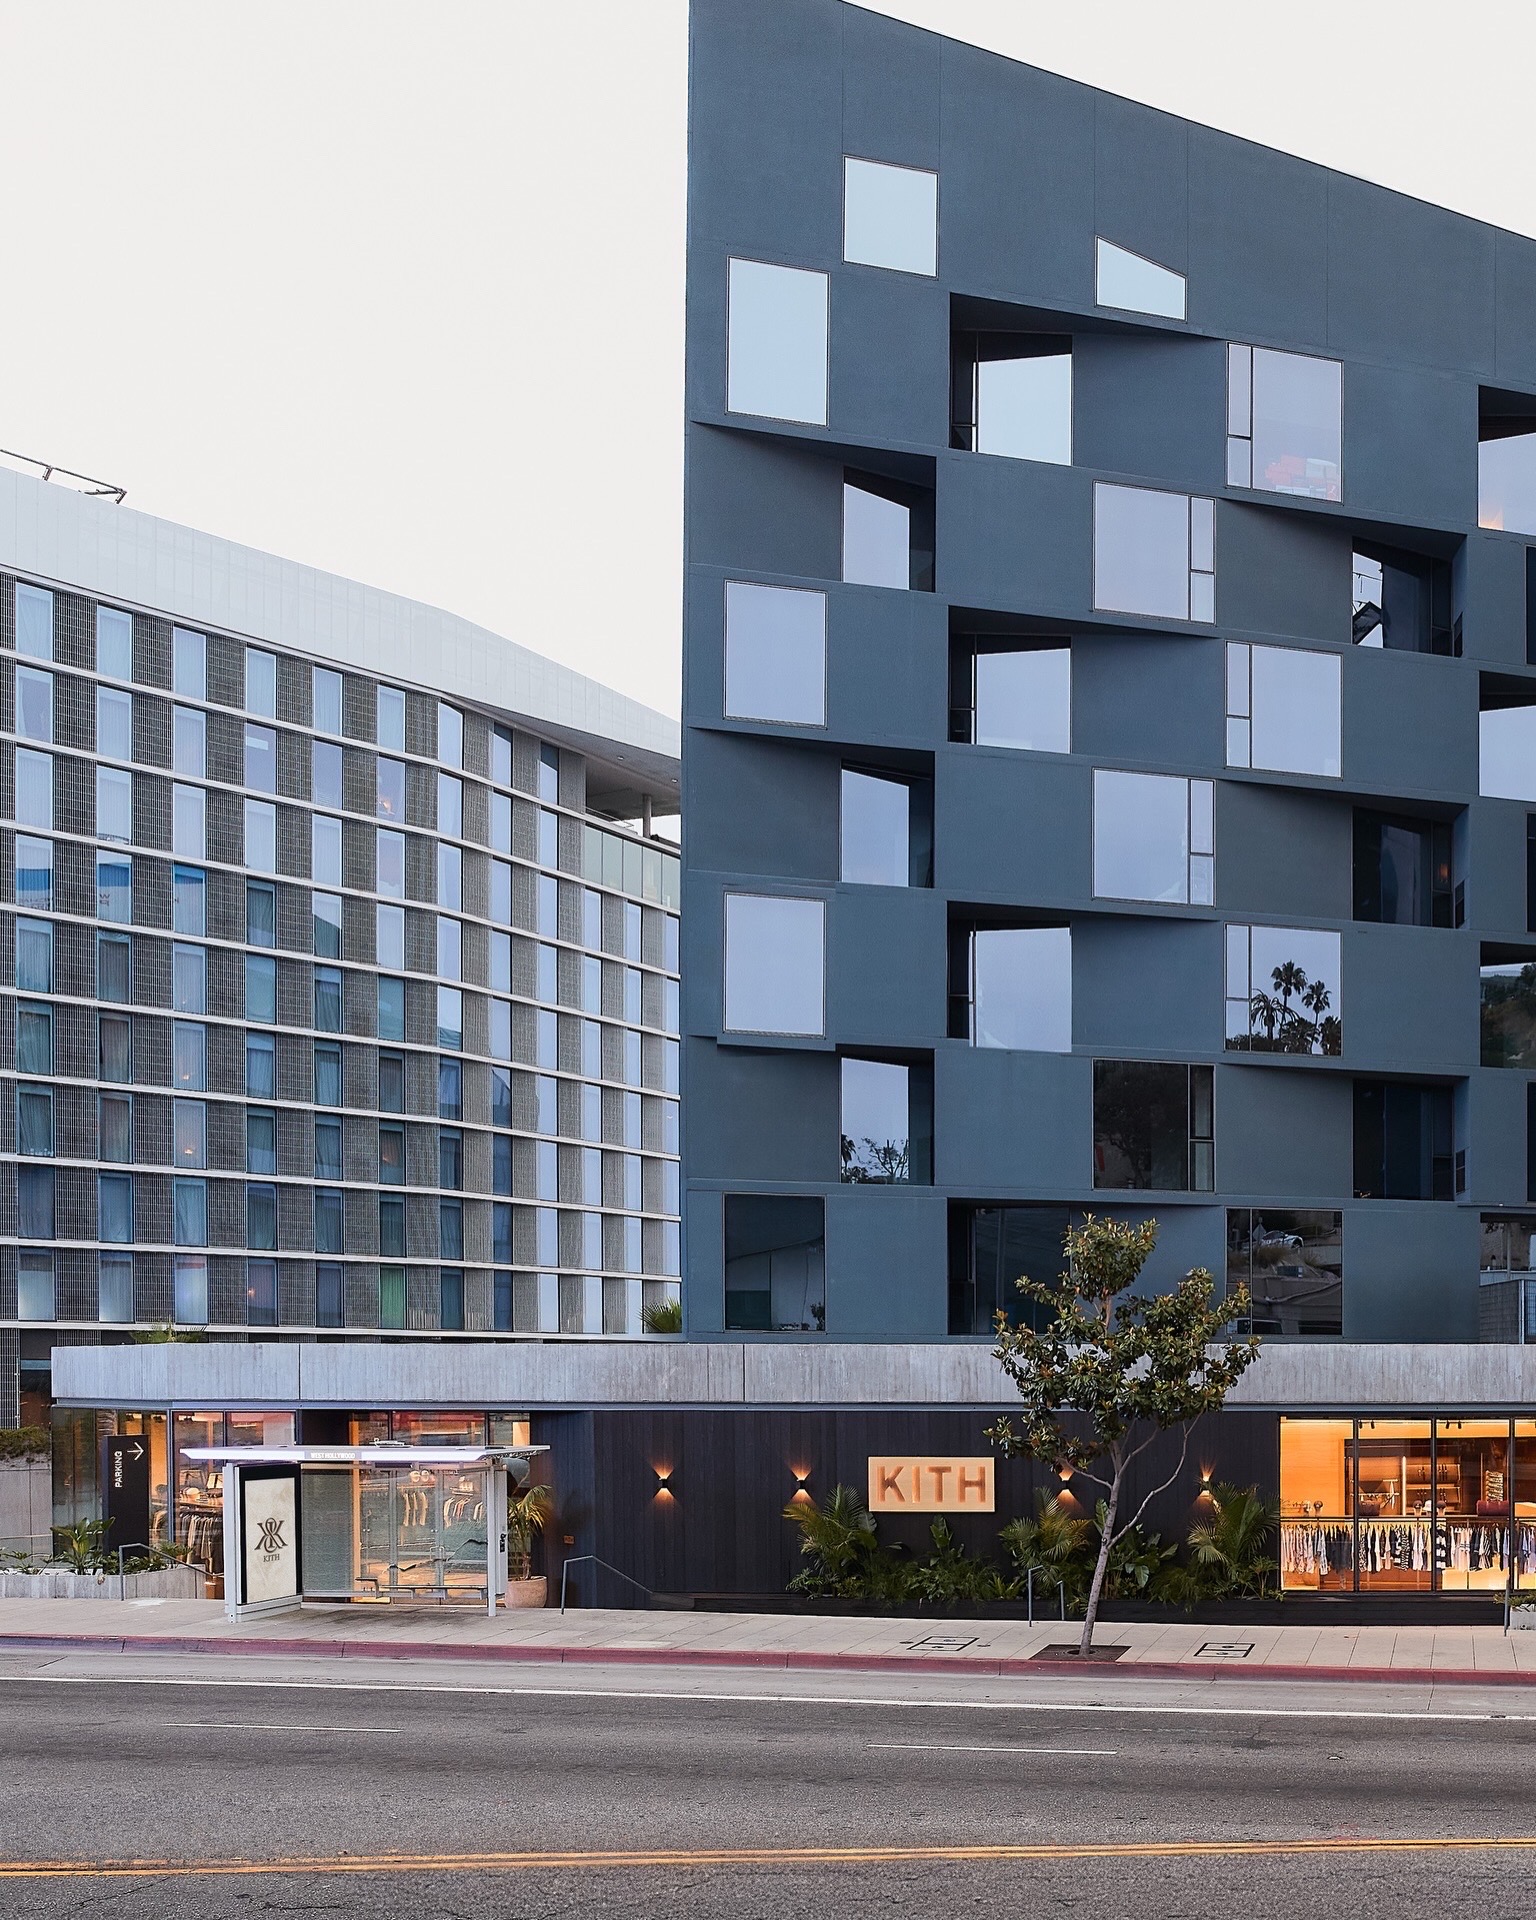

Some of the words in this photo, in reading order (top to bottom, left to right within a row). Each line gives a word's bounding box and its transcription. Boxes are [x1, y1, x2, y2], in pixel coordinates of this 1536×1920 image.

[114, 1450, 123, 1488] PARKING
[876, 1466, 986, 1503] KITH
[263, 1553, 280, 1563] KITH
